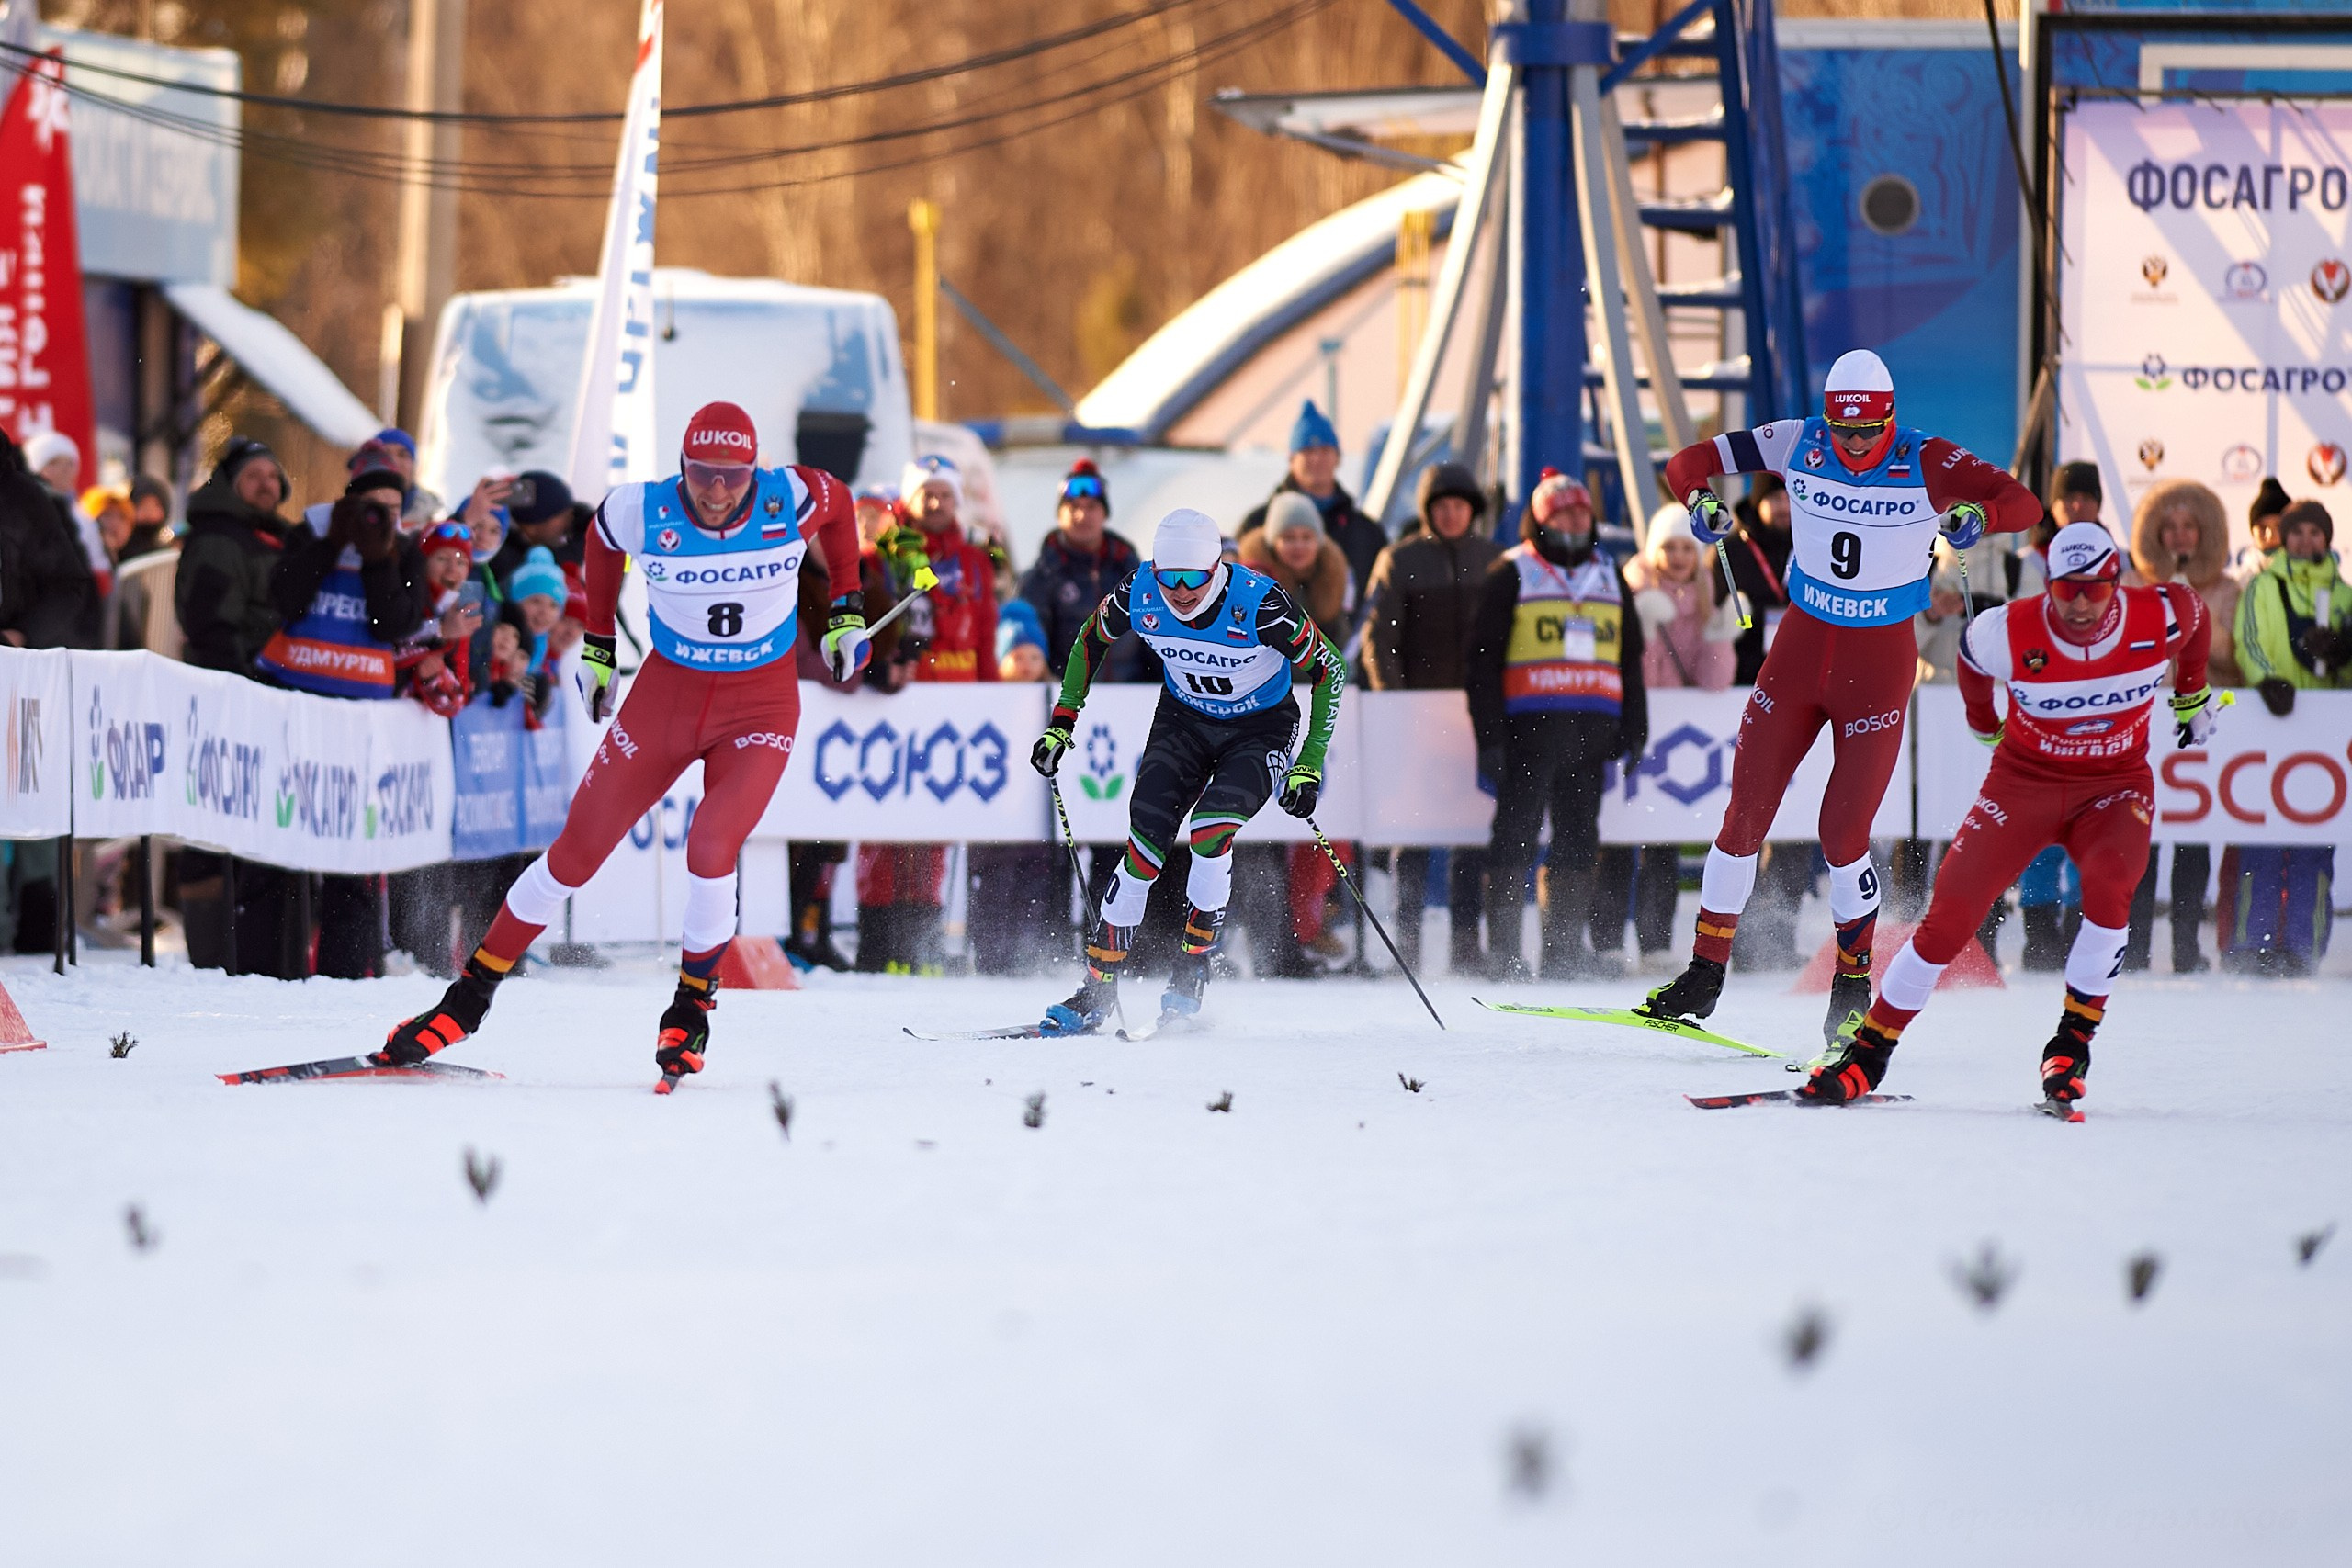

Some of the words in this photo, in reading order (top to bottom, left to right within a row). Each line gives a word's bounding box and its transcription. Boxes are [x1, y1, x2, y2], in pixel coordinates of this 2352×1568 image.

[2127, 159, 2347, 212] ФОСАГРО
[2183, 367, 2346, 393] ФОСАГРО
[1835, 394, 1871, 403] LUKOIL
[692, 430, 752, 449] LUKOIL
[1813, 491, 1916, 516] ФОСАГРО
[1830, 531, 1861, 580] 9
[2061, 542, 2096, 553] LUKOIL
[675, 556, 799, 584] ФОСАГРО
[1804, 583, 1889, 617] ИЖЕВСК
[707, 603, 745, 637] 8
[675, 638, 774, 663] ИЖЕВСК
[1160, 647, 1257, 668] ФОСАГРО
[1312, 641, 1345, 733] TATARSTAN
[1845, 709, 1901, 738] BOSCO
[735, 732, 793, 752] BOSCO
[2040, 733, 2134, 757] ИЖЕВСК
[2051, 735, 2102, 746] России
[814, 718, 1009, 804] СОЮЗ
[1859, 866, 1879, 900] 9
[1644, 1019, 1679, 1032] FISCHER
